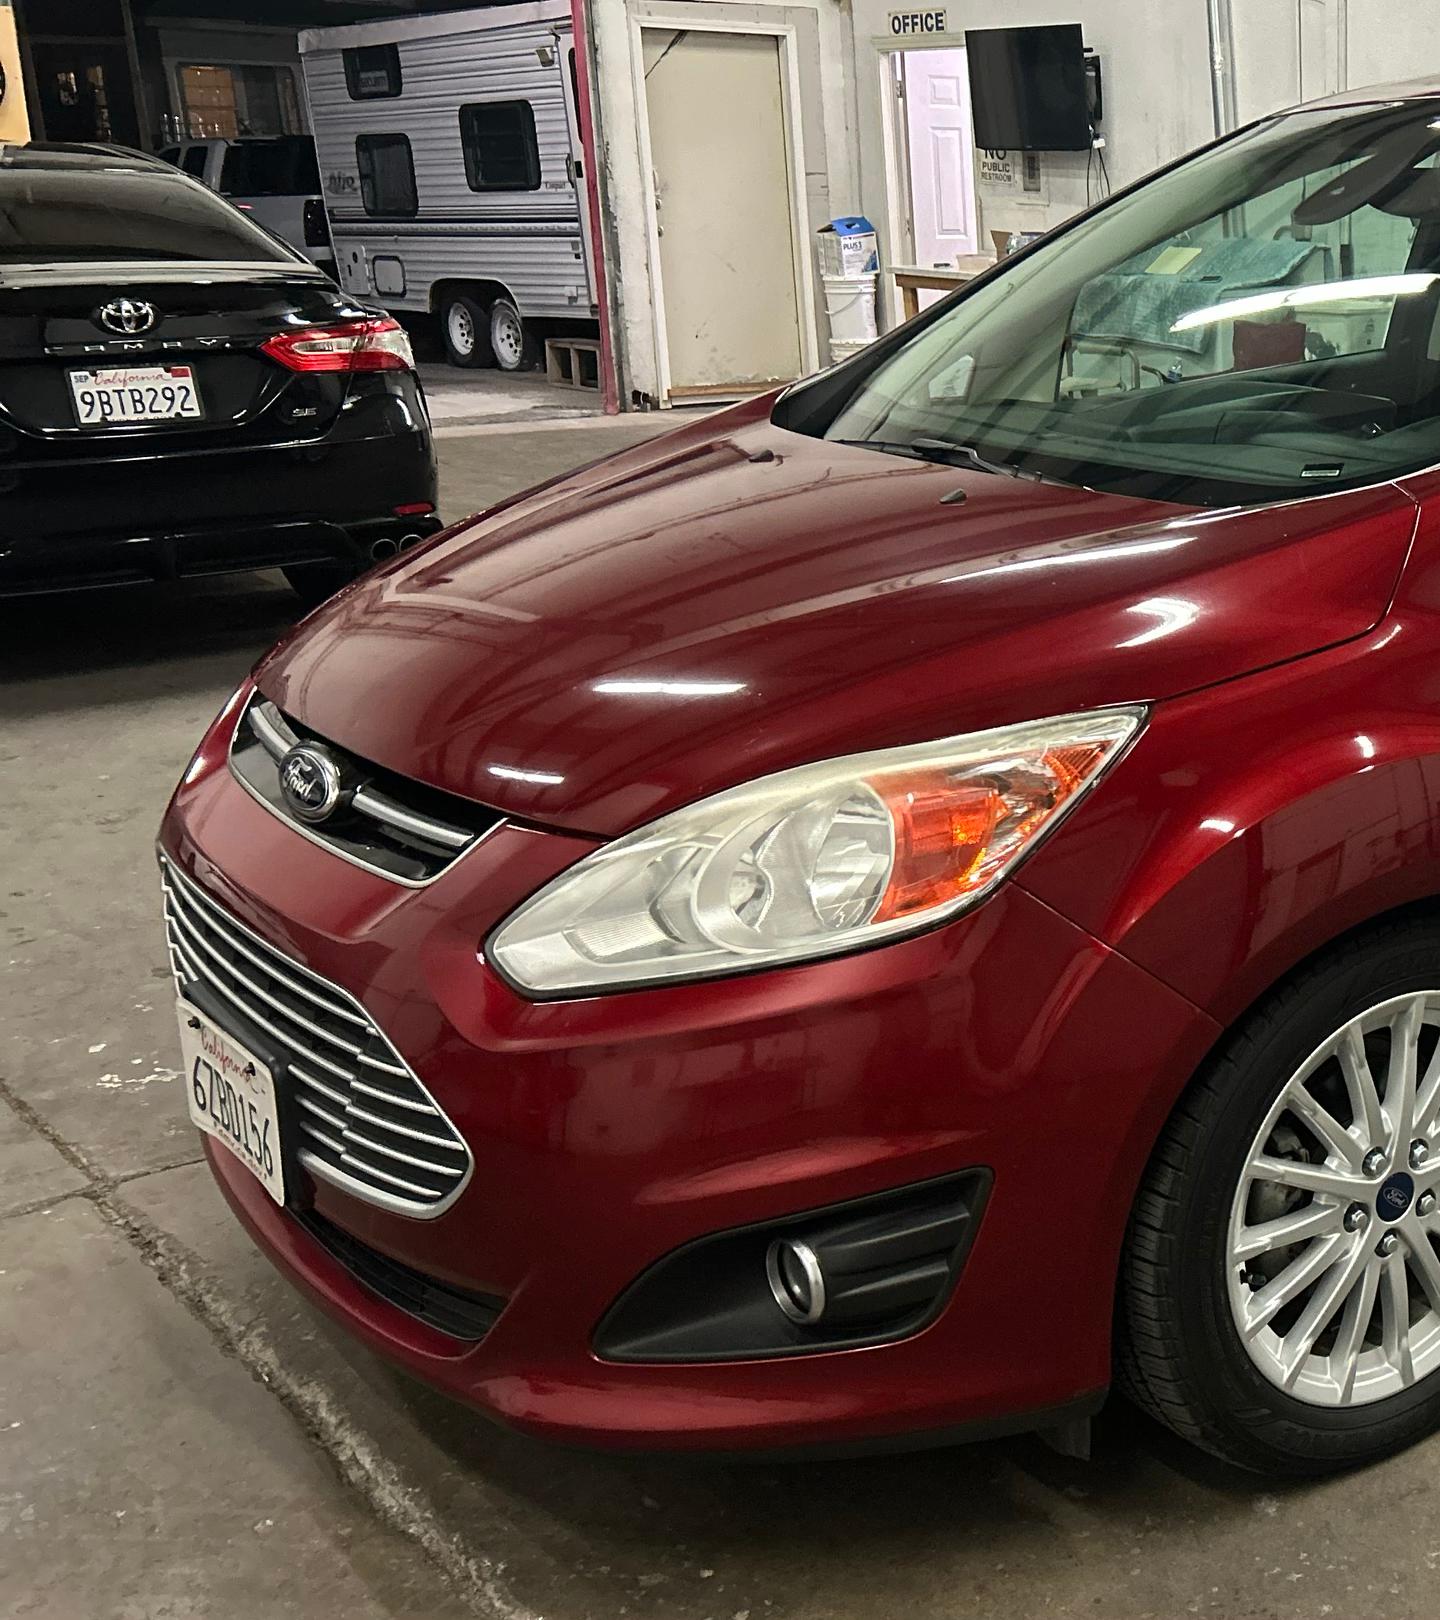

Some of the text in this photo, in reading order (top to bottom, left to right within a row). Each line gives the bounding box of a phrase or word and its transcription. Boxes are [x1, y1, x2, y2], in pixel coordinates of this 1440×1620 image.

[891, 12, 945, 34] OFFICE
[984, 150, 1007, 160] NO
[981, 171, 1012, 182] RESTROOM
[982, 161, 1010, 173] PUBLIC
[73, 374, 89, 383] SEP
[94, 371, 171, 388] California
[80, 385, 195, 418] 9BTB292
[284, 757, 317, 800] Ford
[201, 1025, 256, 1087] California
[193, 1055, 274, 1178] 6ZBD156
